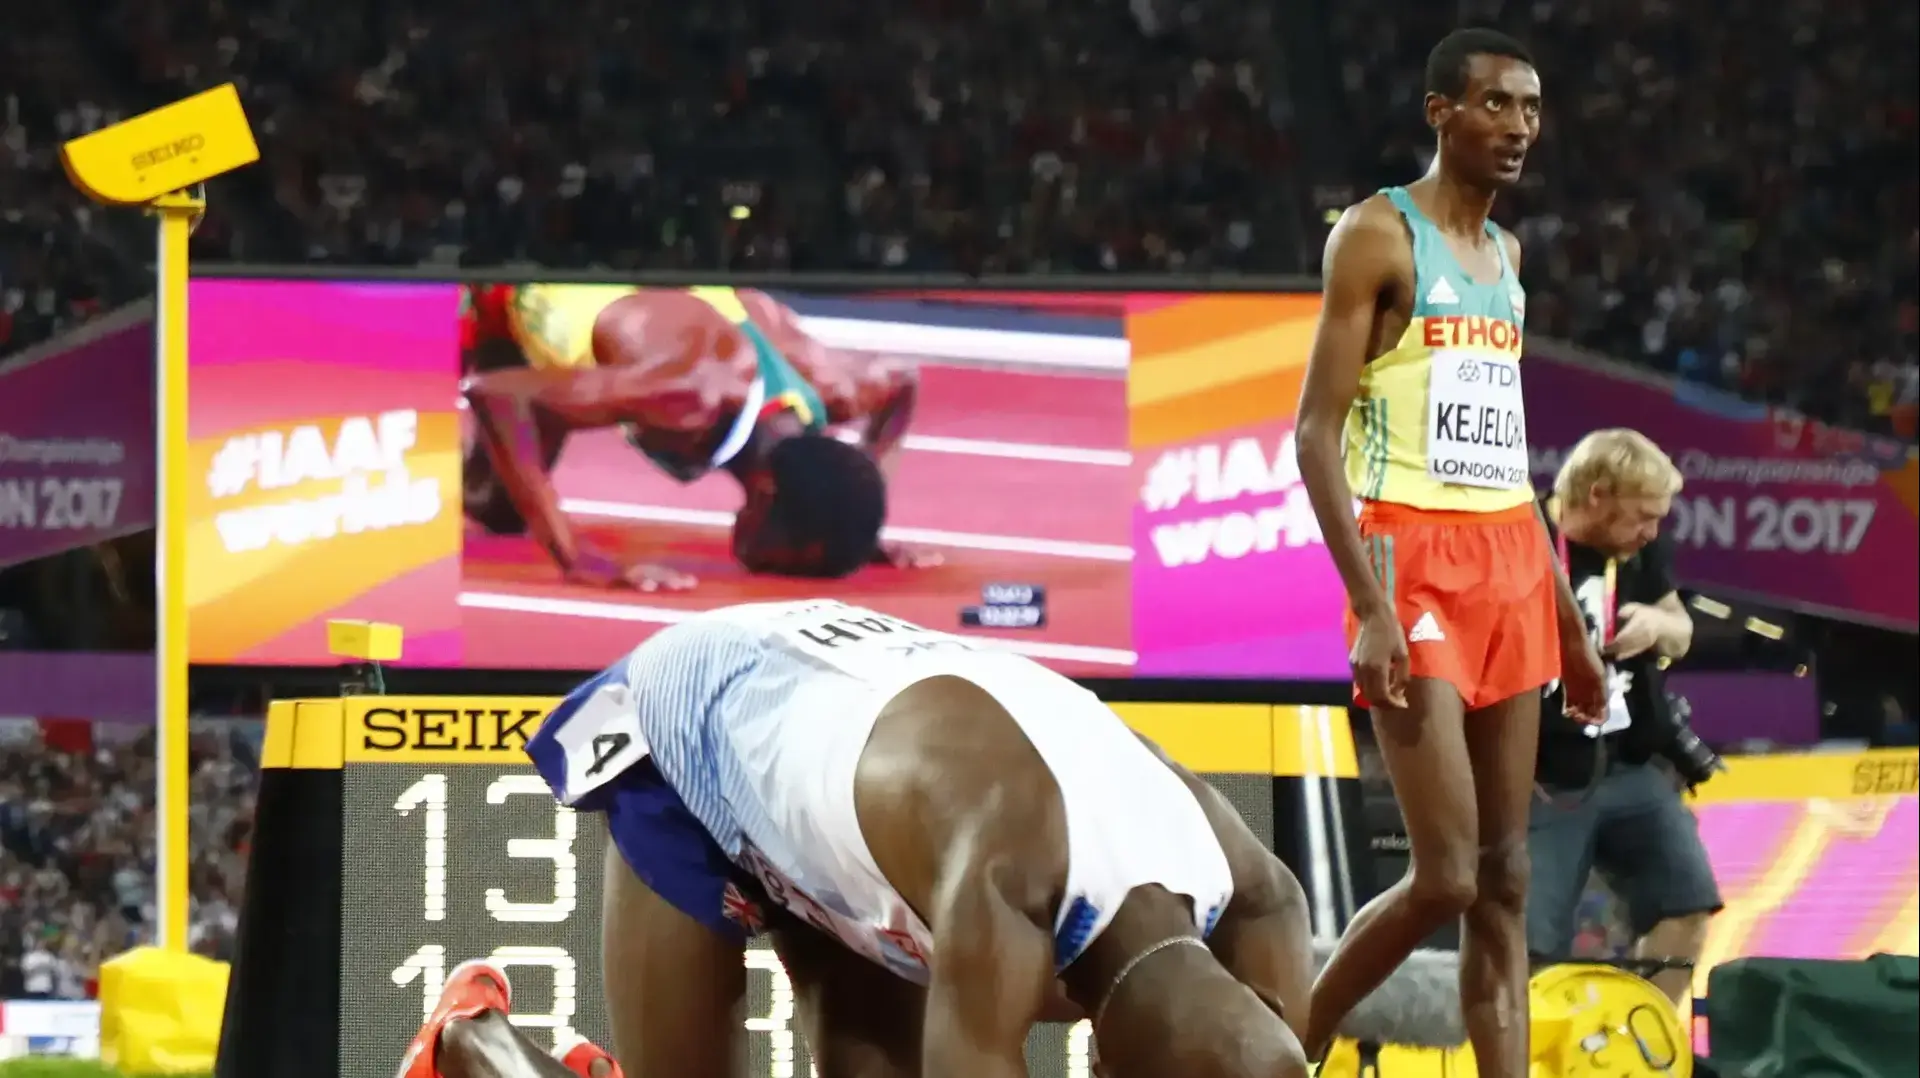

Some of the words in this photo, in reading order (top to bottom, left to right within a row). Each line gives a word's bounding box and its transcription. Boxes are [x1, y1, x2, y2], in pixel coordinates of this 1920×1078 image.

[131, 132, 205, 171] SEIKO
[207, 409, 417, 498] #IAAF
[1433, 459, 1505, 482] LONDON
[41, 477, 122, 530] 2017
[215, 465, 442, 553] worlds
[1745, 495, 1877, 554] 2017
[364, 708, 548, 751] SEIK
[585, 732, 632, 778] 4
[394, 774, 577, 922] 13
